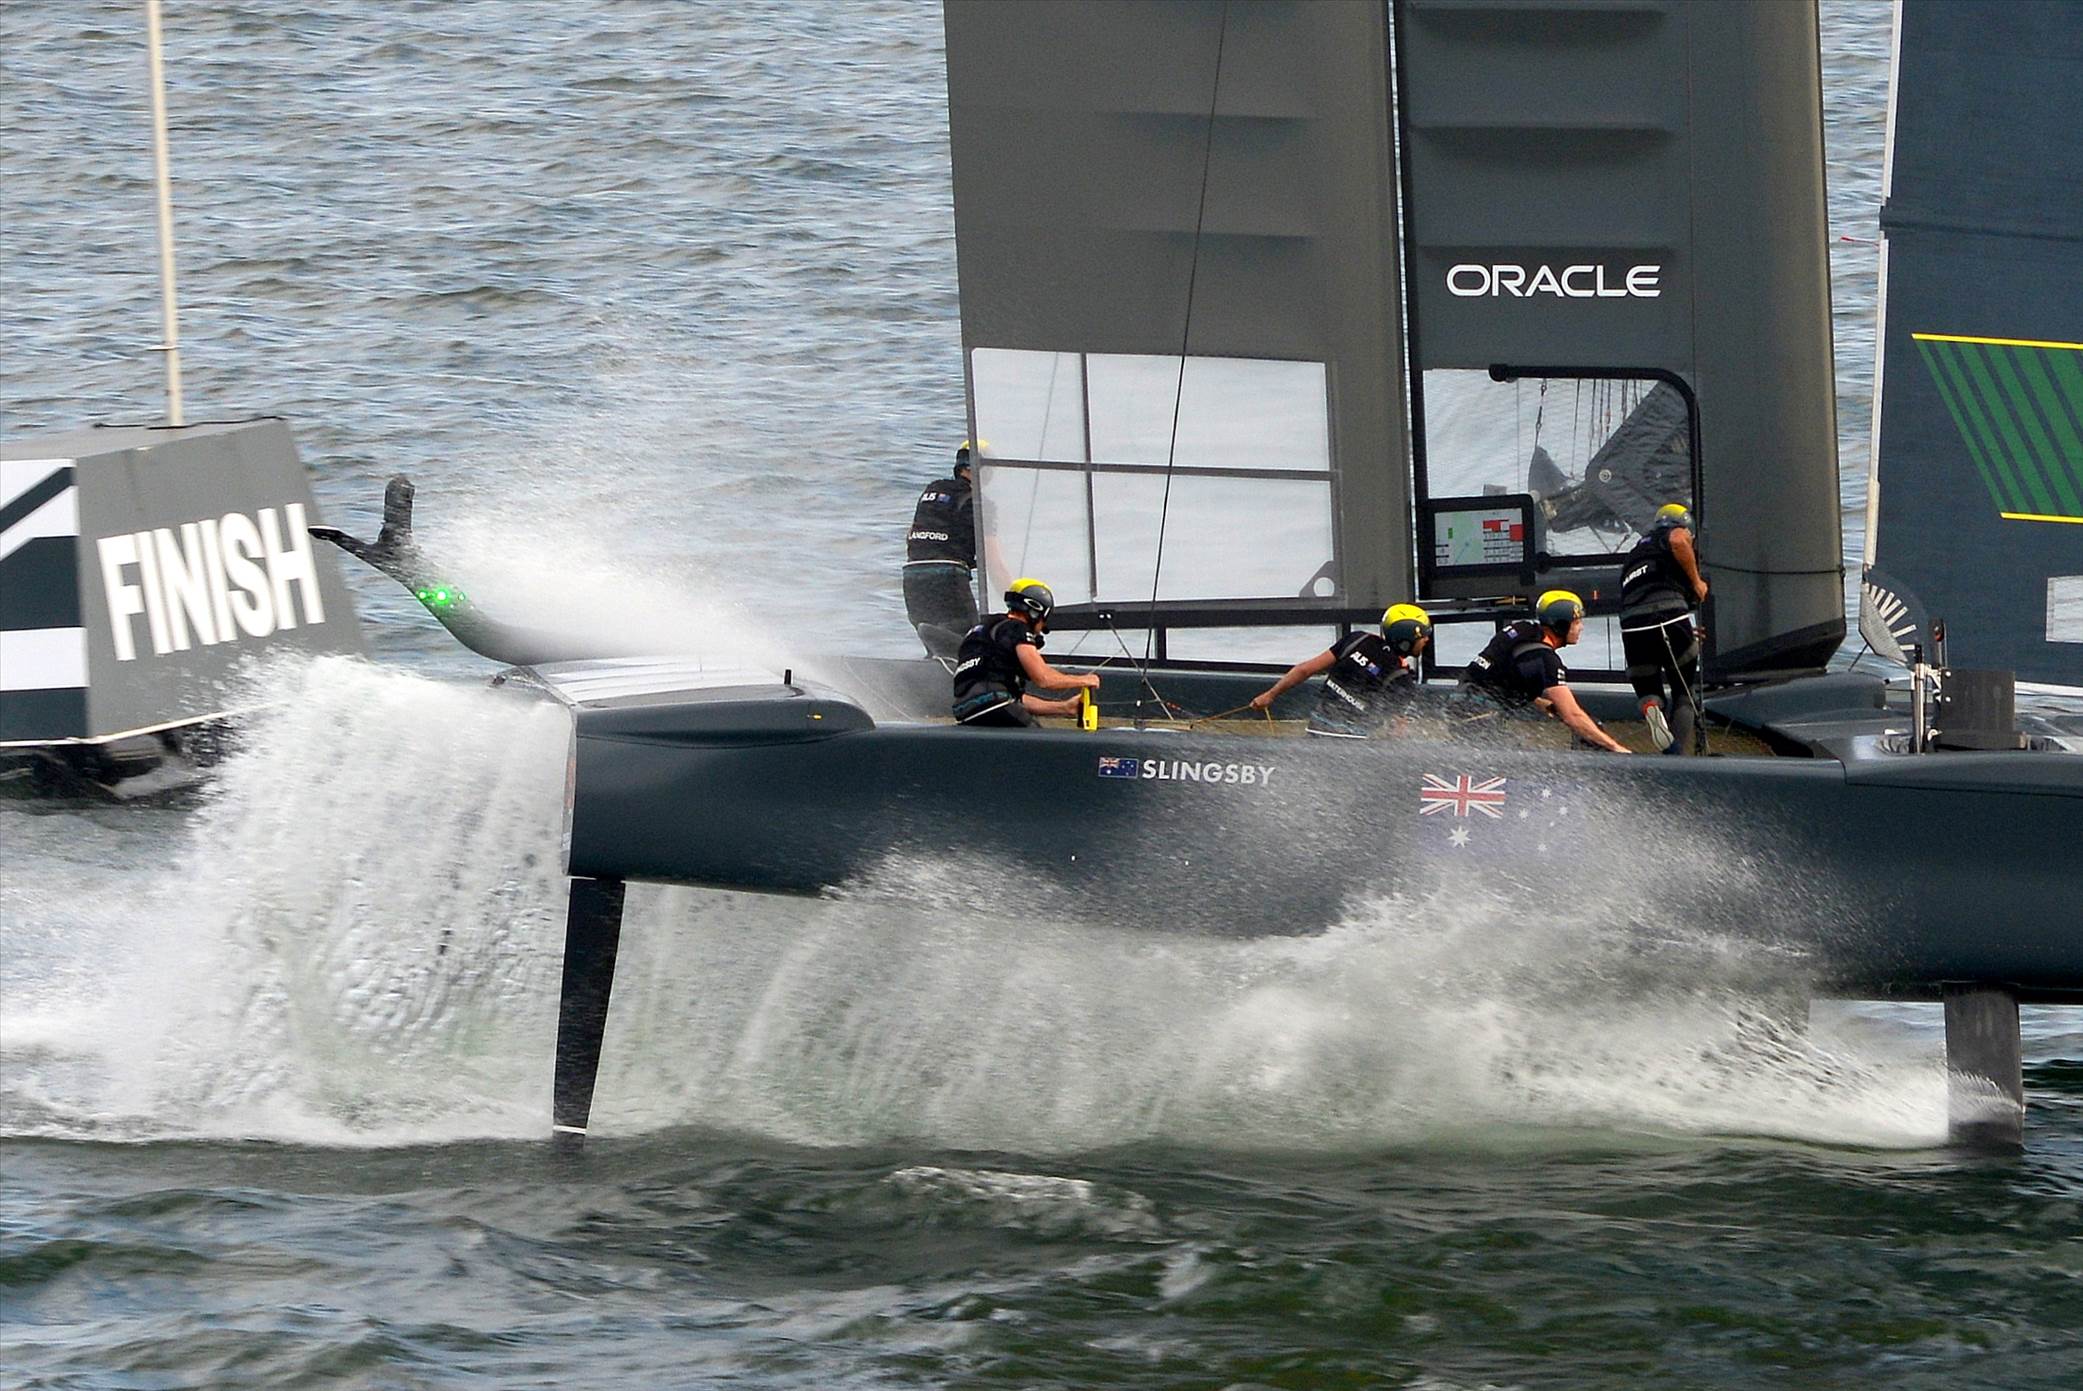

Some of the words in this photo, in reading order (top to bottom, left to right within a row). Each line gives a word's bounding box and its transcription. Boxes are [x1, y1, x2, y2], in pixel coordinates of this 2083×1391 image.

[1446, 264, 1661, 298] ORACLE
[97, 503, 325, 661] FINISH
[1350, 651, 1369, 667] AUS
[1142, 759, 1276, 785] SLINGSBY
